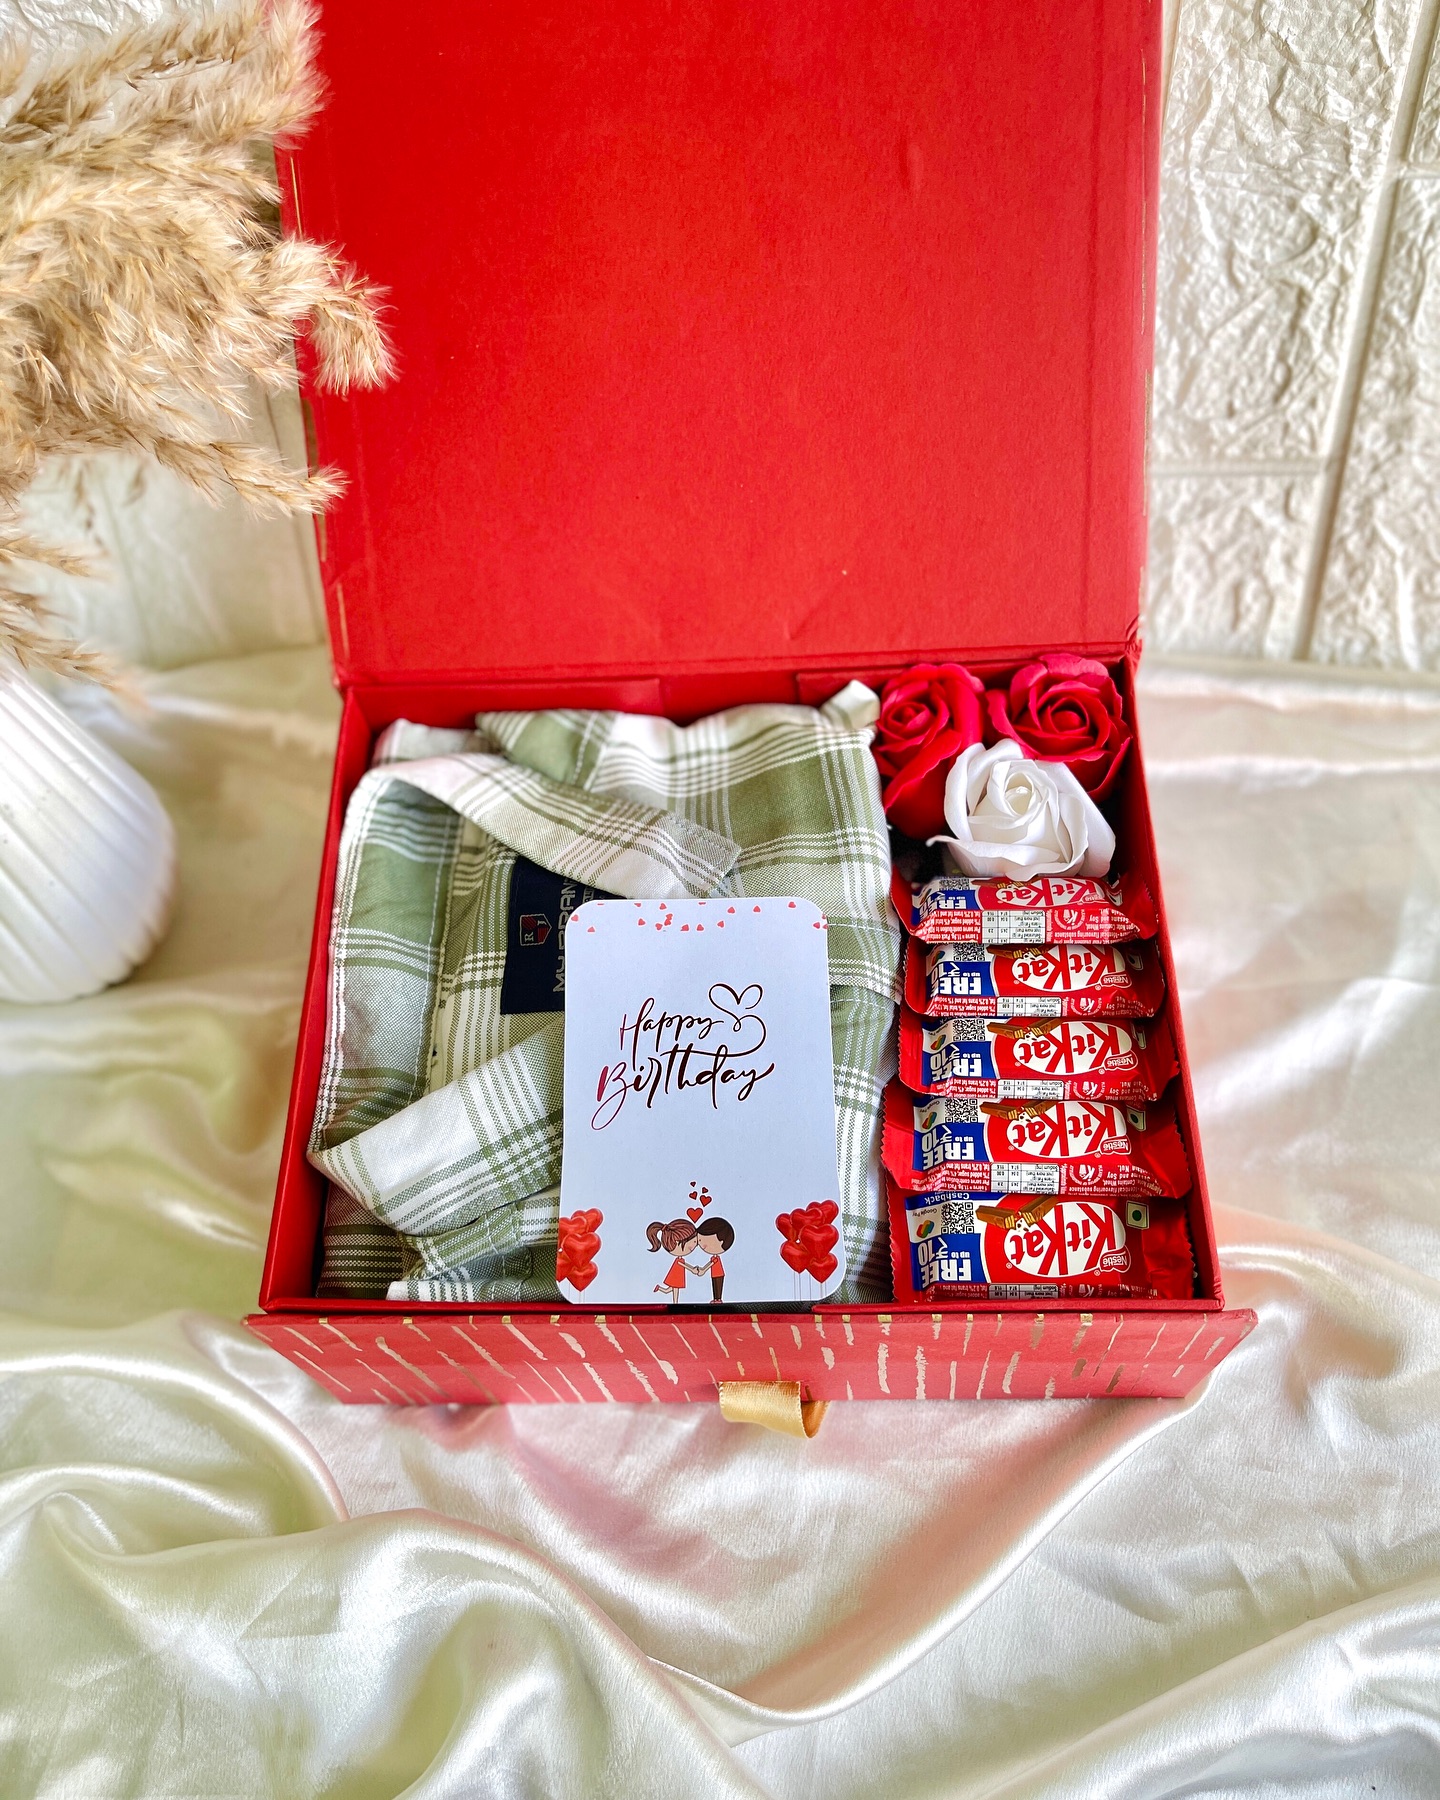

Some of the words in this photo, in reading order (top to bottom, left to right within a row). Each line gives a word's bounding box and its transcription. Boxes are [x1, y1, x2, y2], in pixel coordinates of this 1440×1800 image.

[524, 931, 535, 943] R
[930, 976, 982, 997] FREE
[619, 997, 724, 1072] Happy
[931, 1058, 982, 1081] FREE
[591, 1043, 775, 1130] Birthday
[921, 1124, 952, 1152] ₹10
[922, 1142, 974, 1170] FREE
[924, 1192, 970, 1205] Cashback
[912, 1209, 920, 1217] Pay
[920, 1208, 938, 1216] Google
[918, 1237, 948, 1266] ₹10
[920, 1259, 972, 1288] FREE
